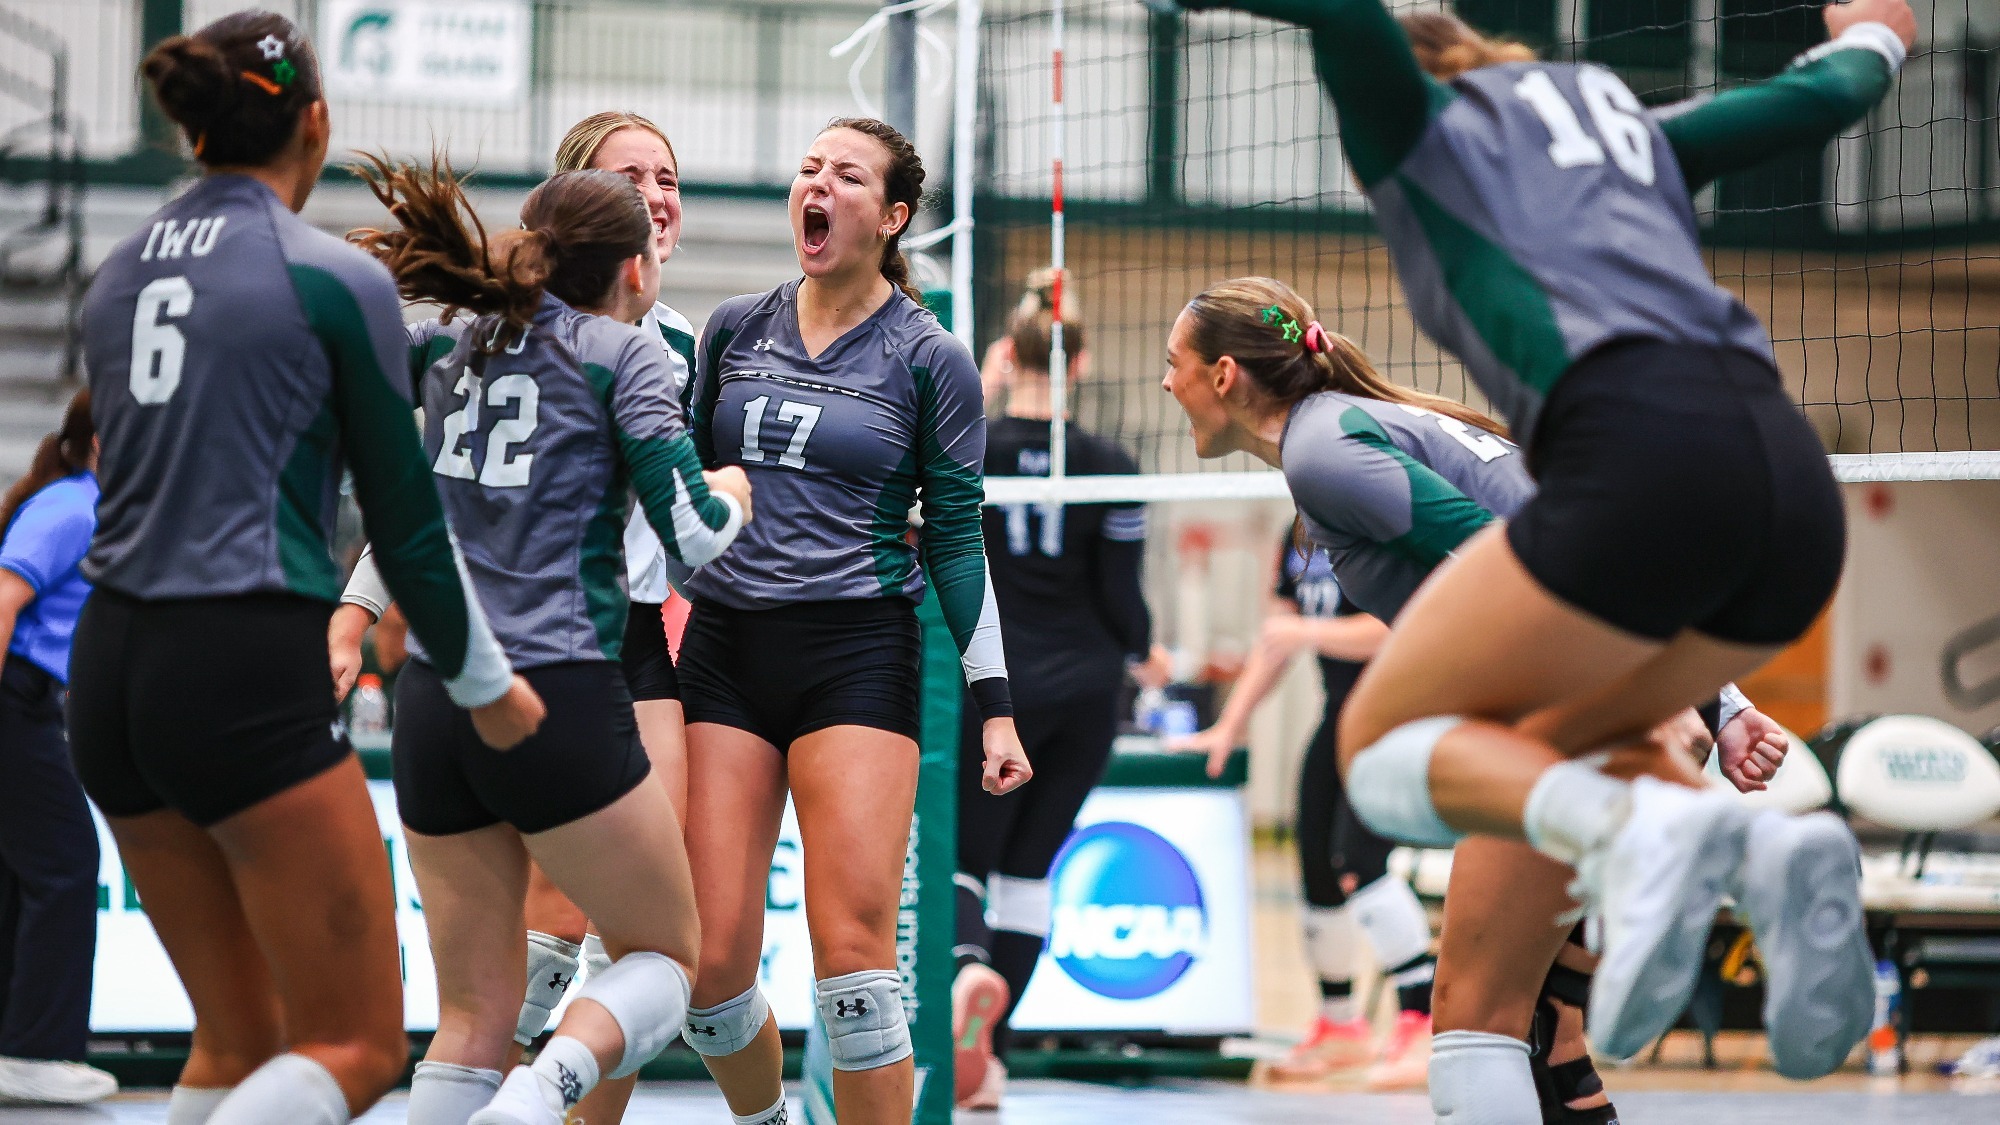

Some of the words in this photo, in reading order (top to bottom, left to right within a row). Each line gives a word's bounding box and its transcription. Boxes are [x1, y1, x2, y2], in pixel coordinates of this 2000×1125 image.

[1513, 63, 1656, 188] 16
[139, 214, 227, 262] IWU
[128, 274, 195, 407] 6
[432, 365, 540, 488] 22
[739, 394, 825, 471] 17
[1051, 902, 1207, 960] NCAA
